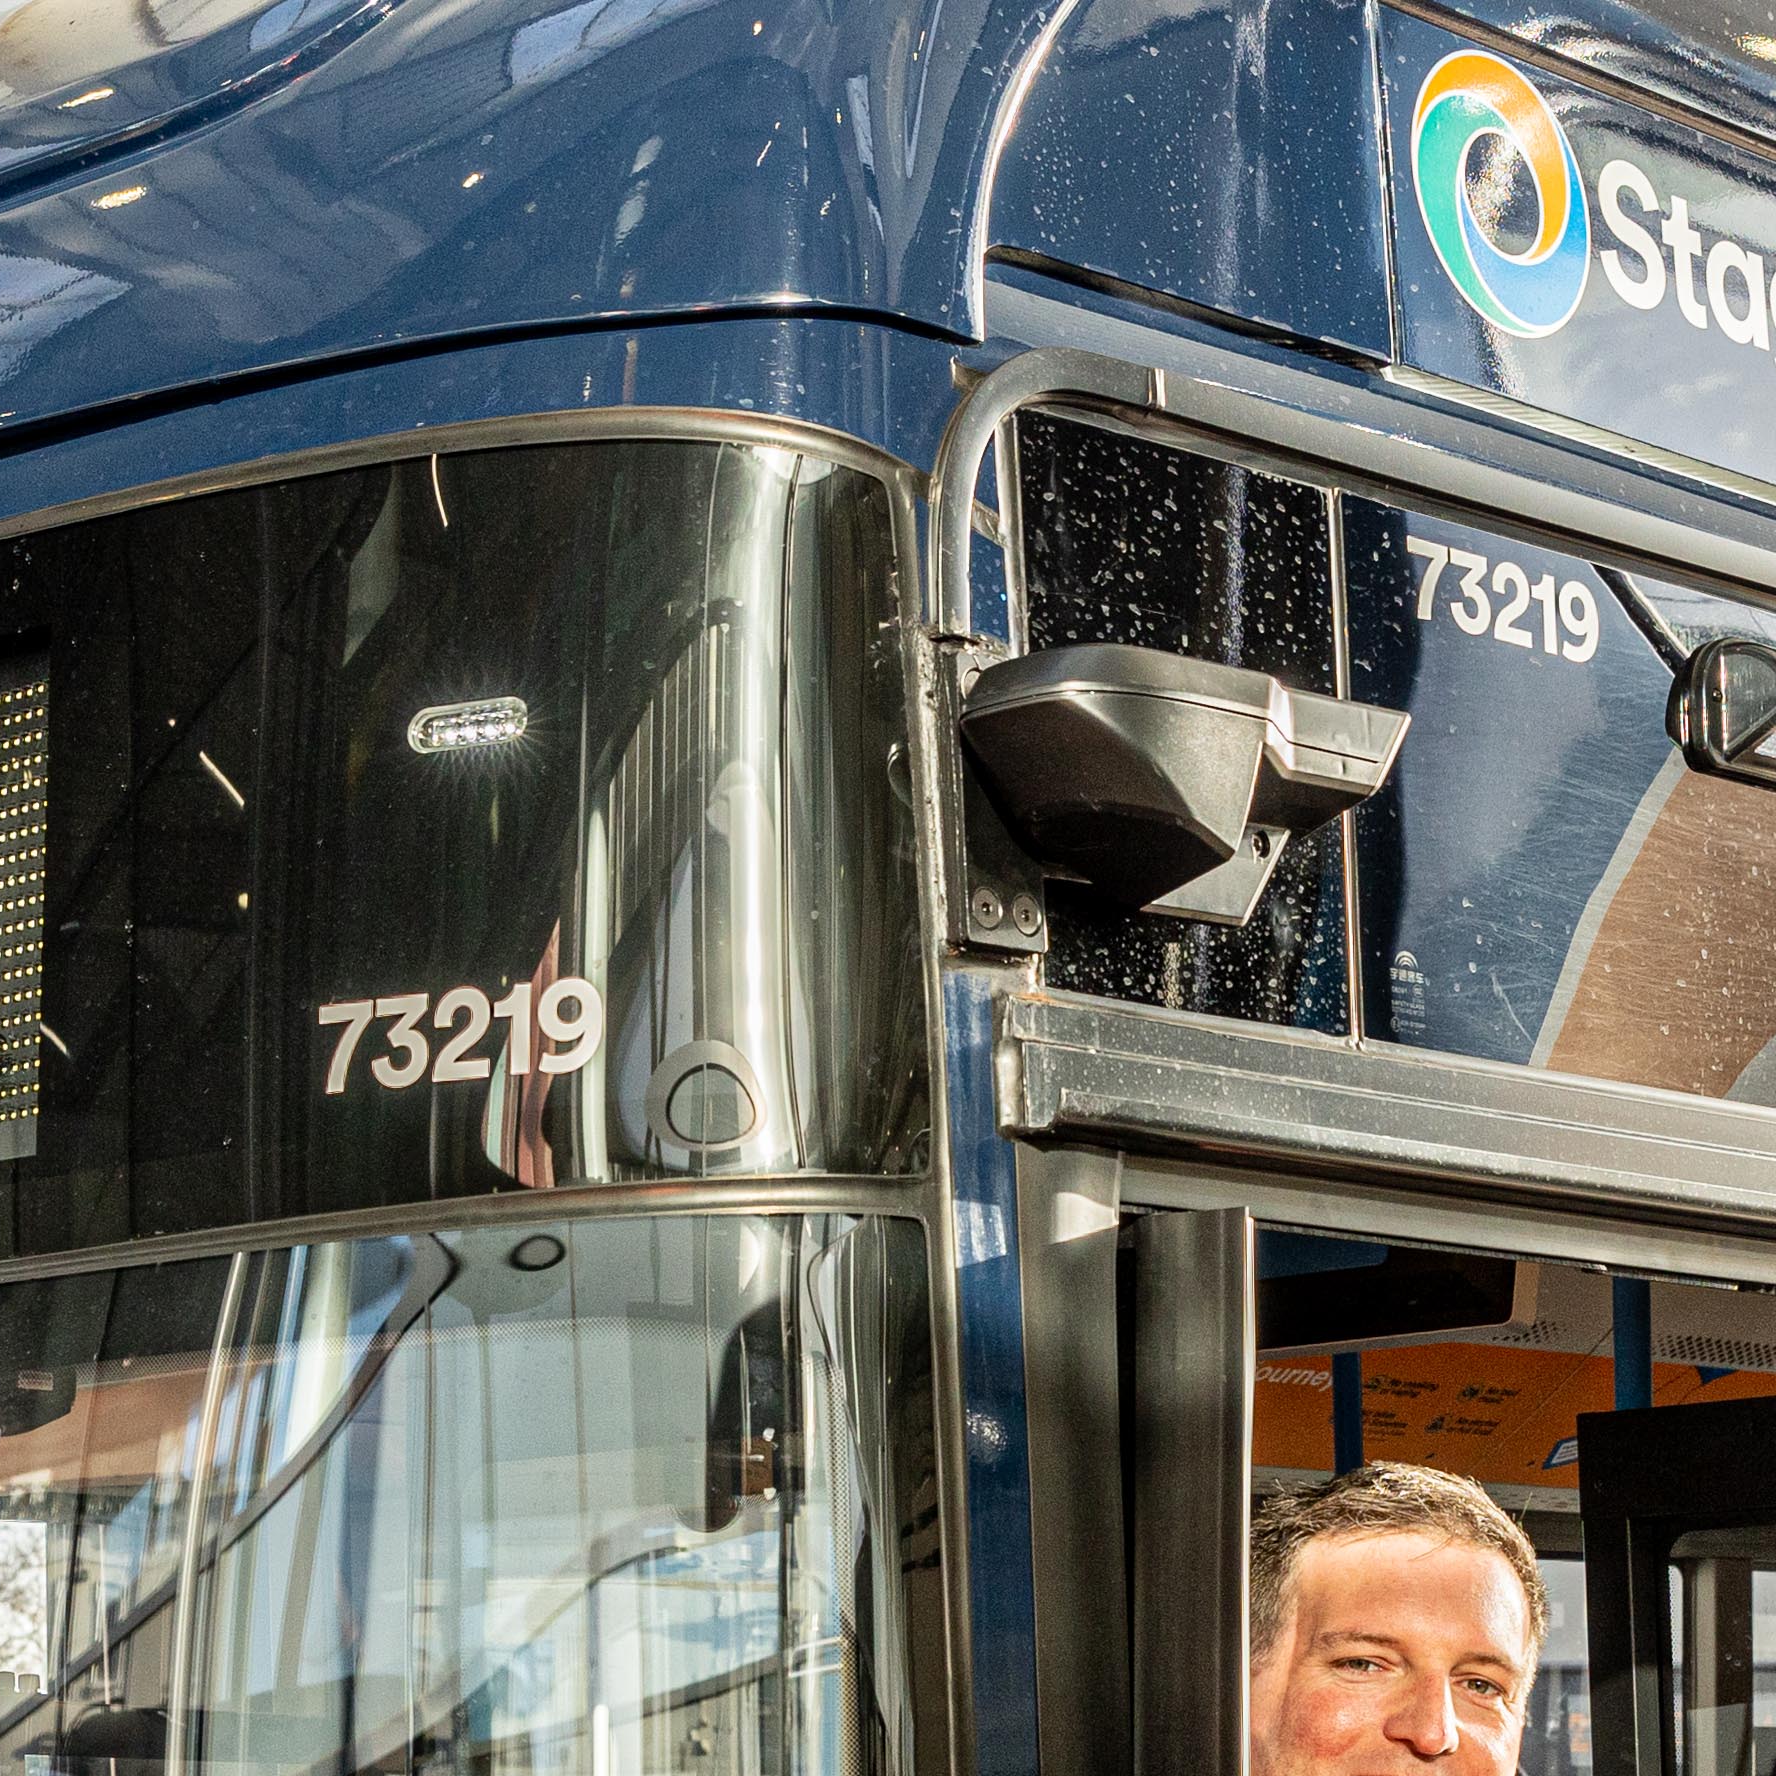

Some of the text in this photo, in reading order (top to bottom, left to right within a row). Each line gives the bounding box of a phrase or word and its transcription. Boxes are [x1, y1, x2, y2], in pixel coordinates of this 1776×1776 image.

[1406, 535, 1600, 664] 73219
[317, 977, 603, 1095] 73219
[1256, 1366, 1333, 1393] ourney
